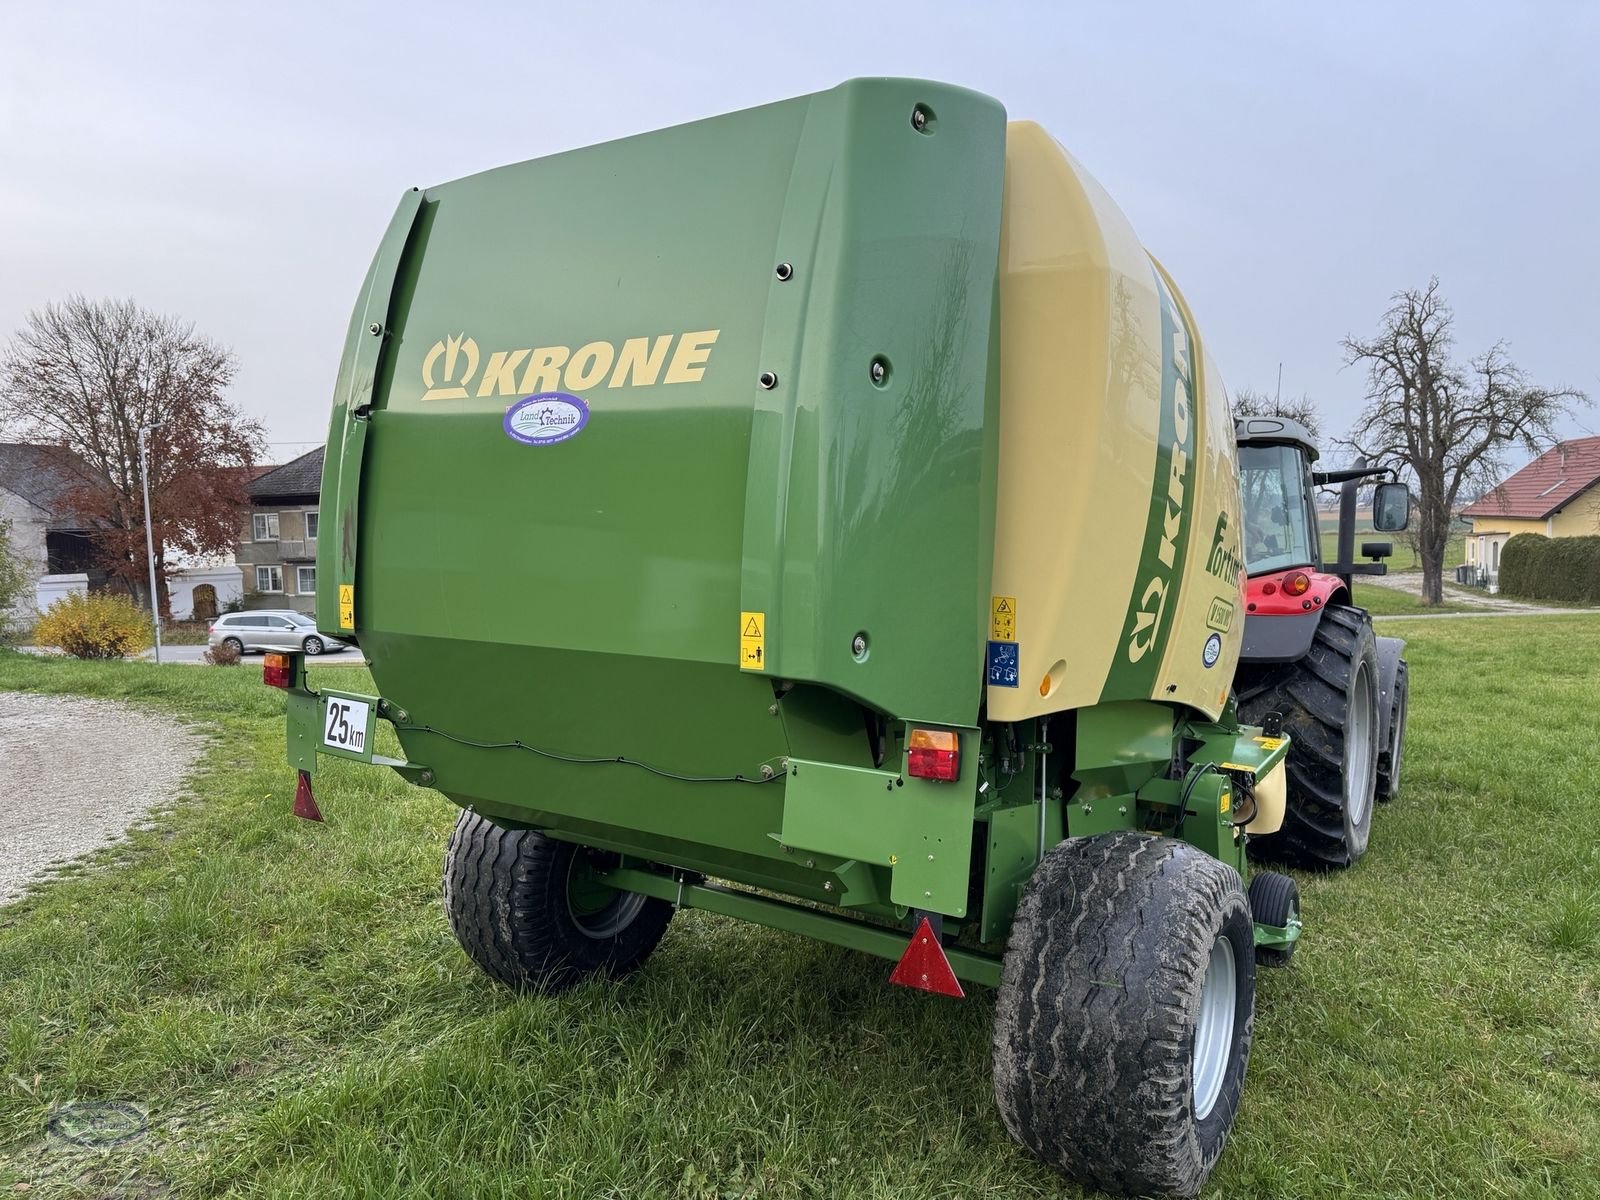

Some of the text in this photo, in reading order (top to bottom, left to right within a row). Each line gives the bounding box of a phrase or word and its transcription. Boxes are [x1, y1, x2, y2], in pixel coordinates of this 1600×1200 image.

[476, 329, 721, 398] KRONE
[520, 410, 576, 426] Land Technik
[1158, 302, 1188, 570] KRON
[1205, 510, 1242, 588] Fortim
[327, 702, 364, 748] 25 km
